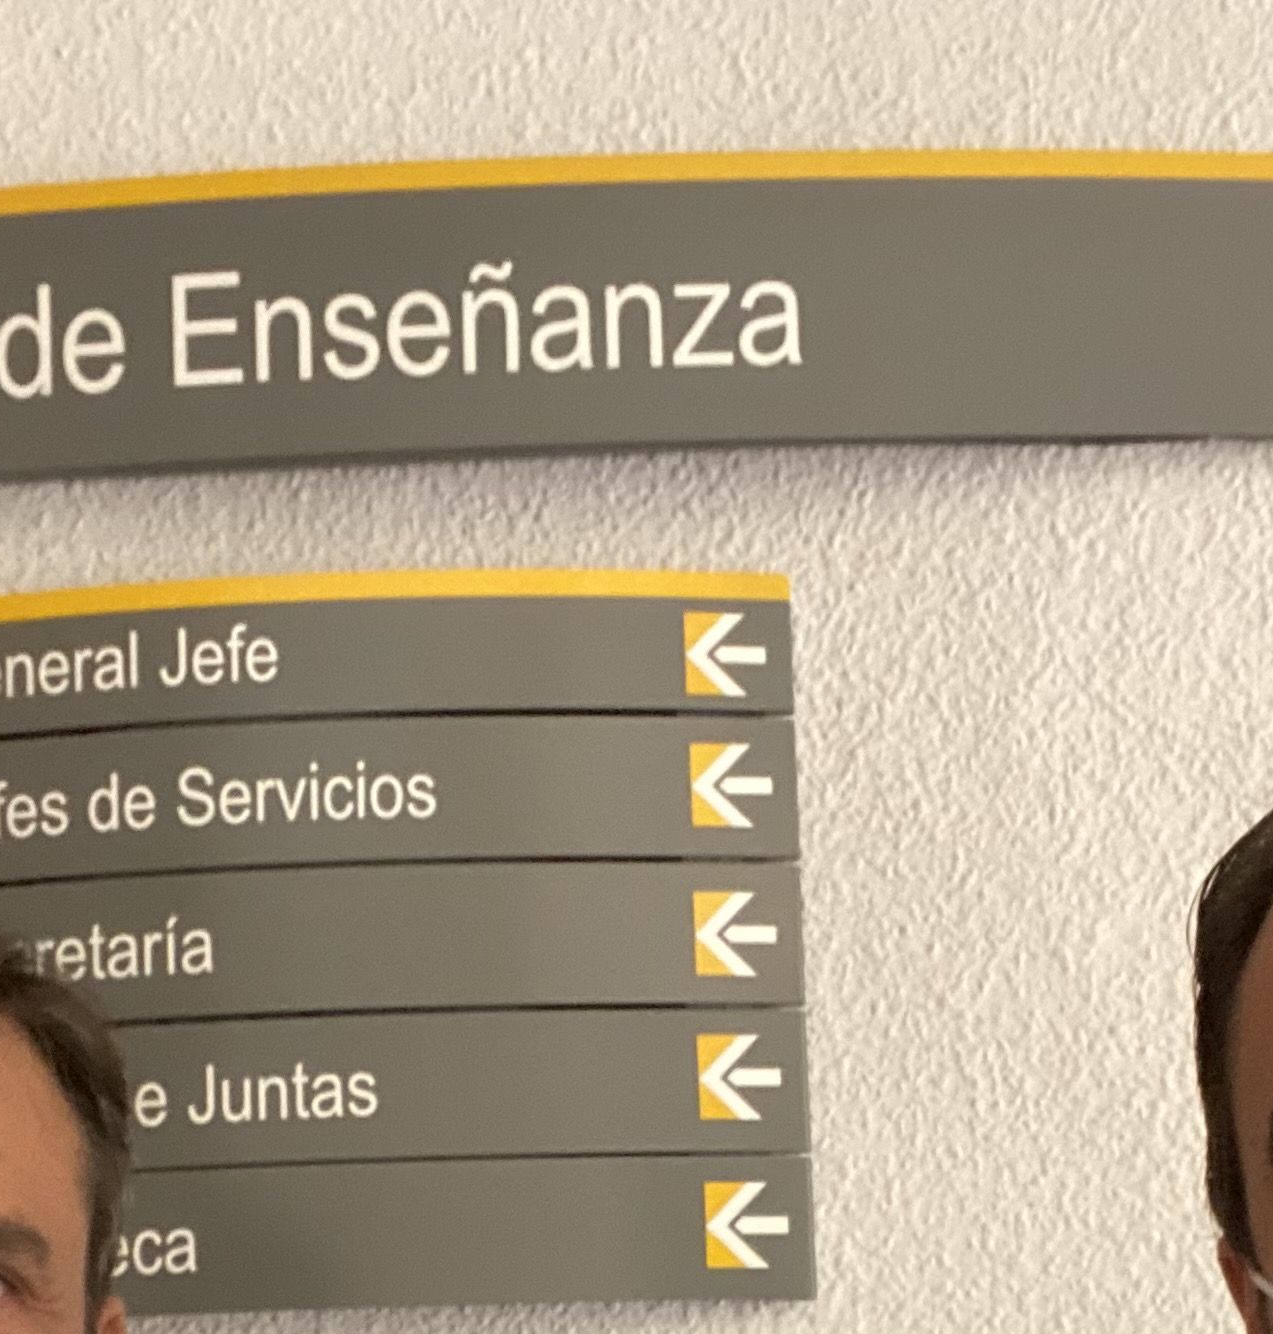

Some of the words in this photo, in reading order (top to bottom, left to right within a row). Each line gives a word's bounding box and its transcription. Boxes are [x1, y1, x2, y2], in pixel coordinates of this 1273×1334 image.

[171, 259, 804, 388] Enseñanza
[159, 621, 280, 688] Jefe
[87, 771, 157, 832] de
[175, 758, 438, 828] Servicios
[28, 913, 214, 981] retaría
[133, 1081, 168, 1128] e
[186, 1061, 379, 1125] Juntas
